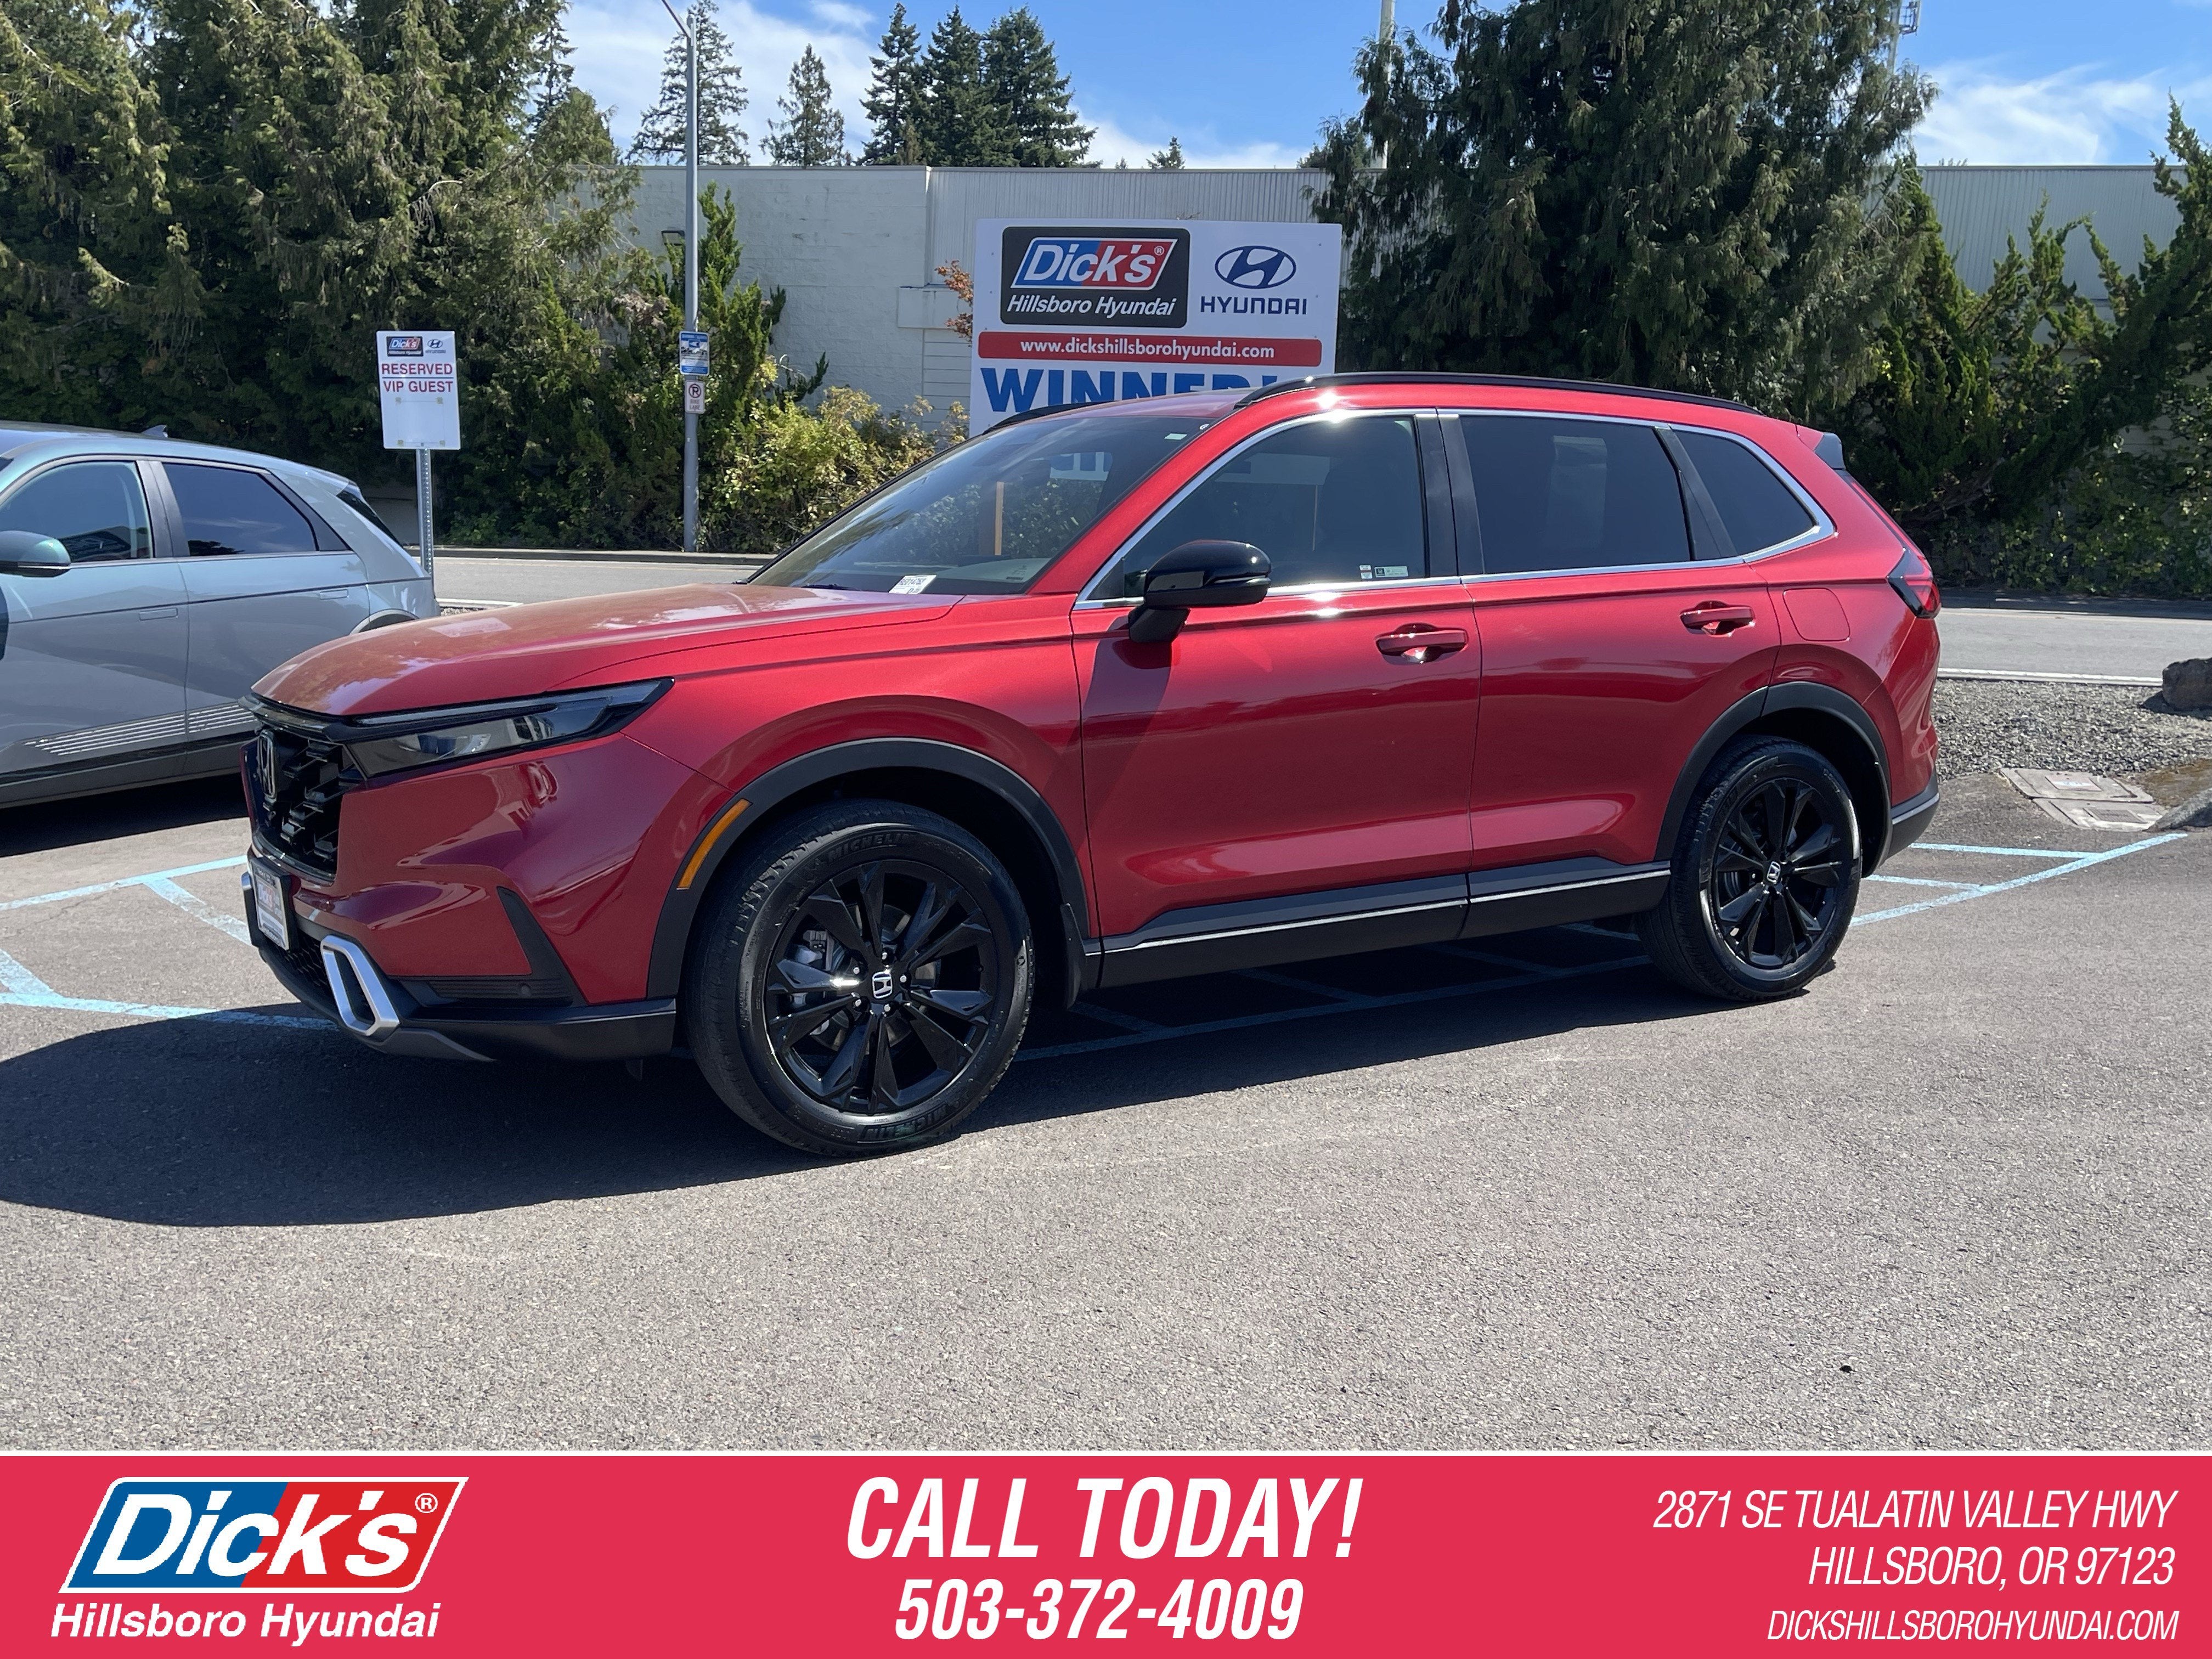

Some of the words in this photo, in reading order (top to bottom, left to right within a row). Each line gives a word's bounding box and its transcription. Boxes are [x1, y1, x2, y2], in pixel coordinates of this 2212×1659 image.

[1007, 295, 1092, 314] Hillsboro
[1095, 296, 1177, 319] Hyundai
[1201, 296, 1307, 315] HYUNDAI
[1020, 337, 1274, 360] www.dickshillsborohyundai.com
[381, 363, 453, 375] RESERVED
[383, 381, 404, 392] VIP
[408, 381, 453, 392] GUEST
[981, 368, 1277, 413] WINN
